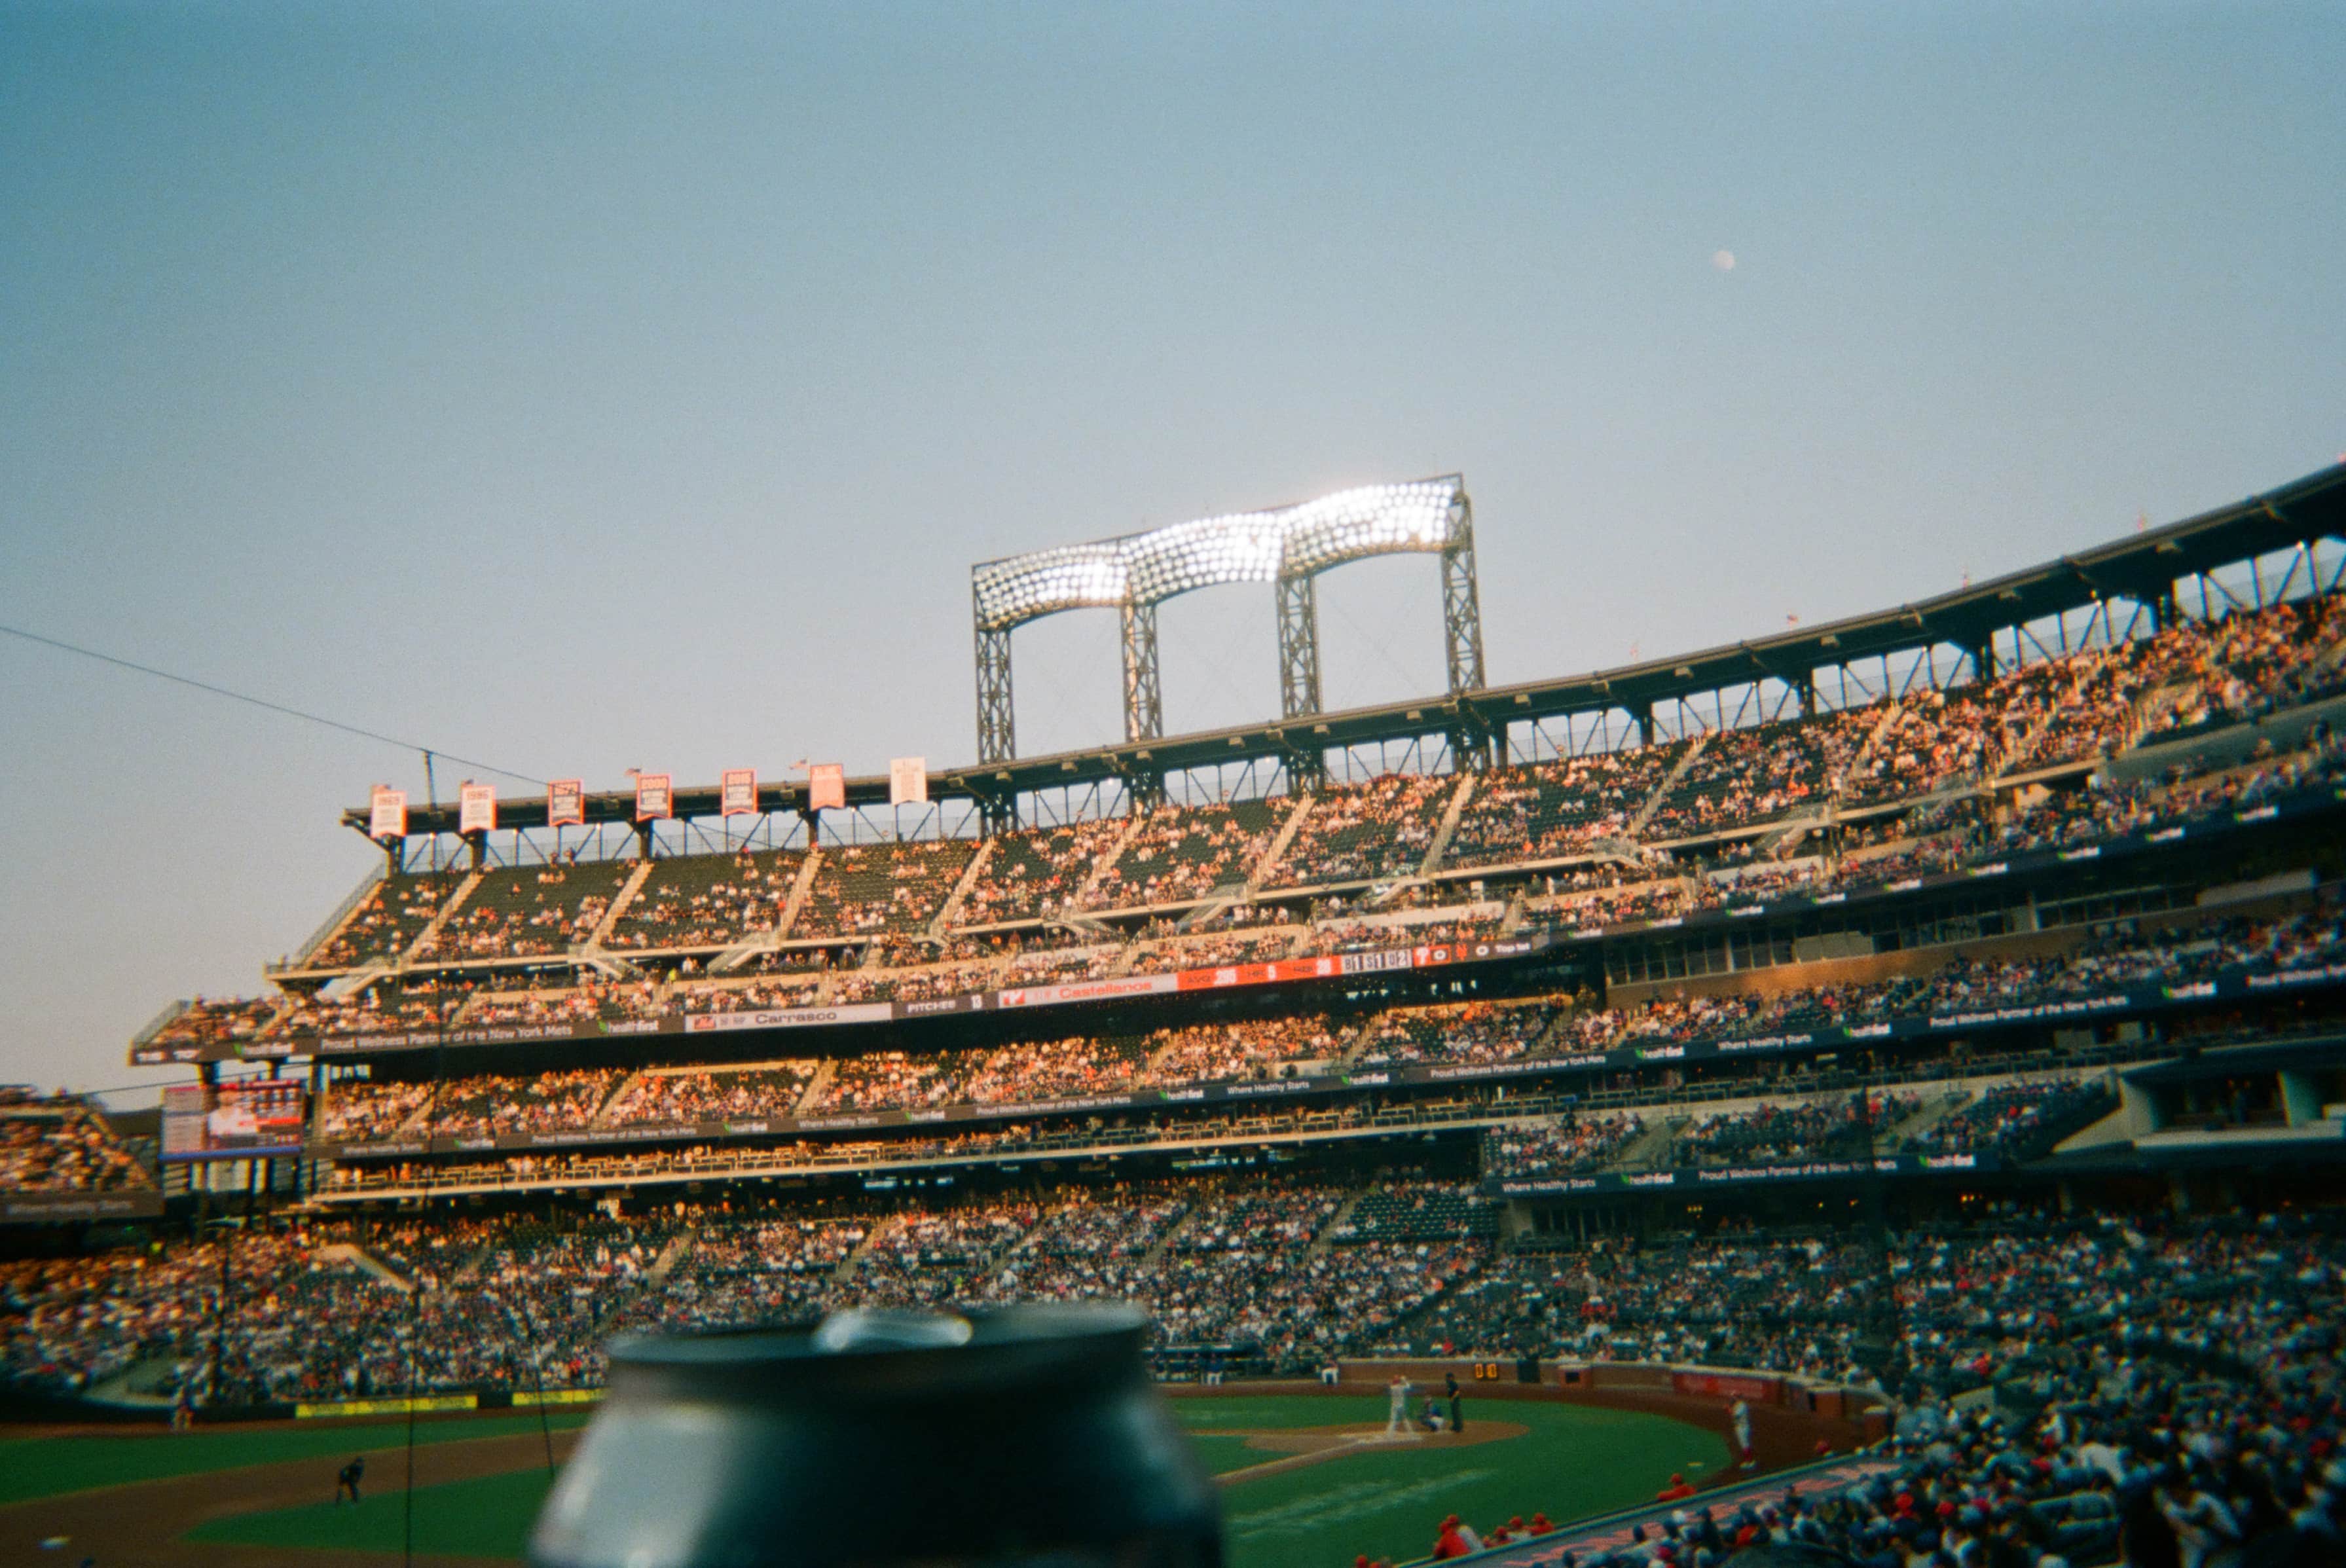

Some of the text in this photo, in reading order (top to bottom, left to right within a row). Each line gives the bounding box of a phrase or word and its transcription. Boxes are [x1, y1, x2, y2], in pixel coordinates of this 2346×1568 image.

[1345, 957, 1353, 970] B
[1366, 955, 1374, 968] S
[1397, 951, 1406, 966] 2
[1059, 983, 1154, 999] Castellanos
[755, 1012, 837, 1025] Carrasco
[1717, 1033, 1813, 1051] Where Healthy Starts
[1430, 1055, 1607, 1079] Proud Wellness Partner of the New York Mets
[1227, 1081, 1310, 1095] Where Healthy Starts
[976, 1107, 998, 1116] Proud
[999, 1104, 1029, 1114] Wellness
[1029, 1103, 1055, 1112] Partner
[1078, 1099, 1096, 1107] New
[1095, 1097, 1113, 1106] York
[1113, 1096, 1131, 1104] Mets
[798, 1120, 824, 1129] Where
[824, 1118, 857, 1129] Healthy
[1698, 1170, 1728, 1181] Proud
[1800, 1163, 1811, 1175] of
[1502, 1178, 1597, 1192] Where Healthy Starts
